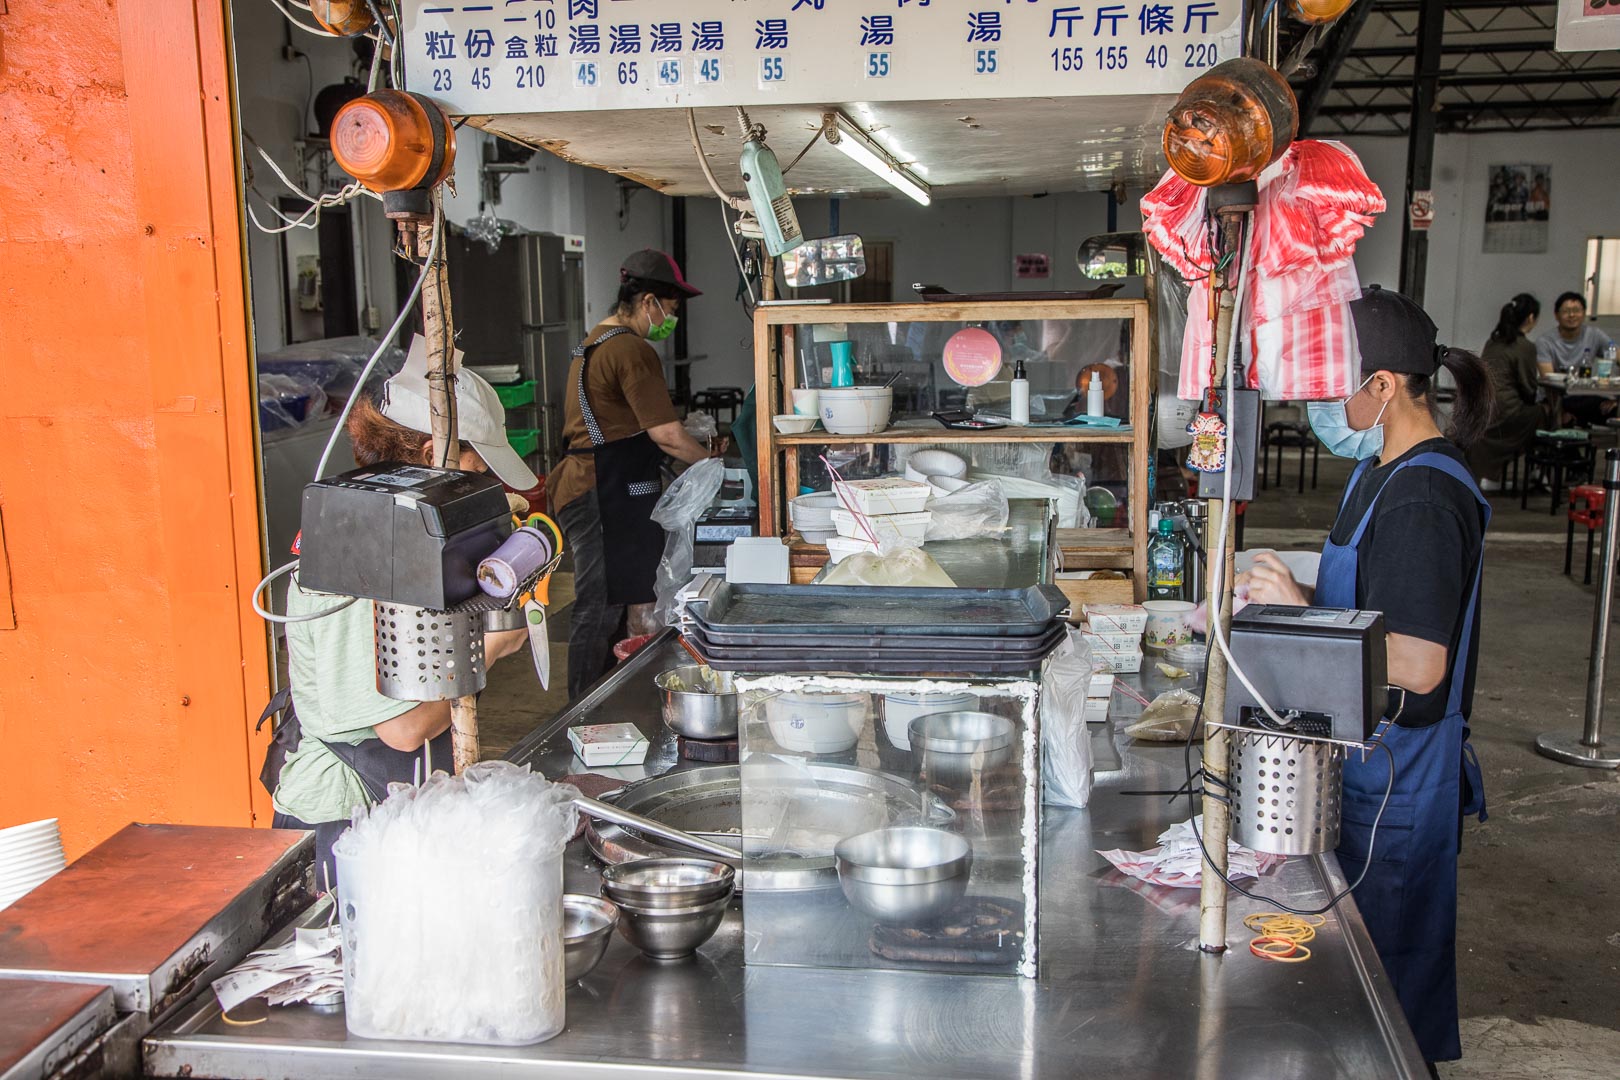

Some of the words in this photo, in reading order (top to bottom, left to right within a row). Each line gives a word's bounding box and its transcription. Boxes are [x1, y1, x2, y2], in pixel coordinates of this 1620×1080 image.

[1049, 6, 1084, 37] 斤
[1093, 5, 1129, 36] 斤
[1138, 4, 1174, 35] 條
[1183, 2, 1219, 34] 斤
[869, 53, 889, 76] 55
[976, 50, 997, 73] 55
[1051, 47, 1083, 71] 155
[1095, 46, 1128, 70] 155
[1145, 44, 1168, 69] 40
[1184, 43, 1218, 67] 220
[433, 69, 452, 91] 23
[471, 67, 491, 90] 45
[516, 65, 545, 88] 210
[577, 63, 596, 85] 45
[618, 61, 638, 84] 65
[660, 61, 679, 83] 45
[700, 59, 720, 82] 45
[763, 57, 783, 80] 55
